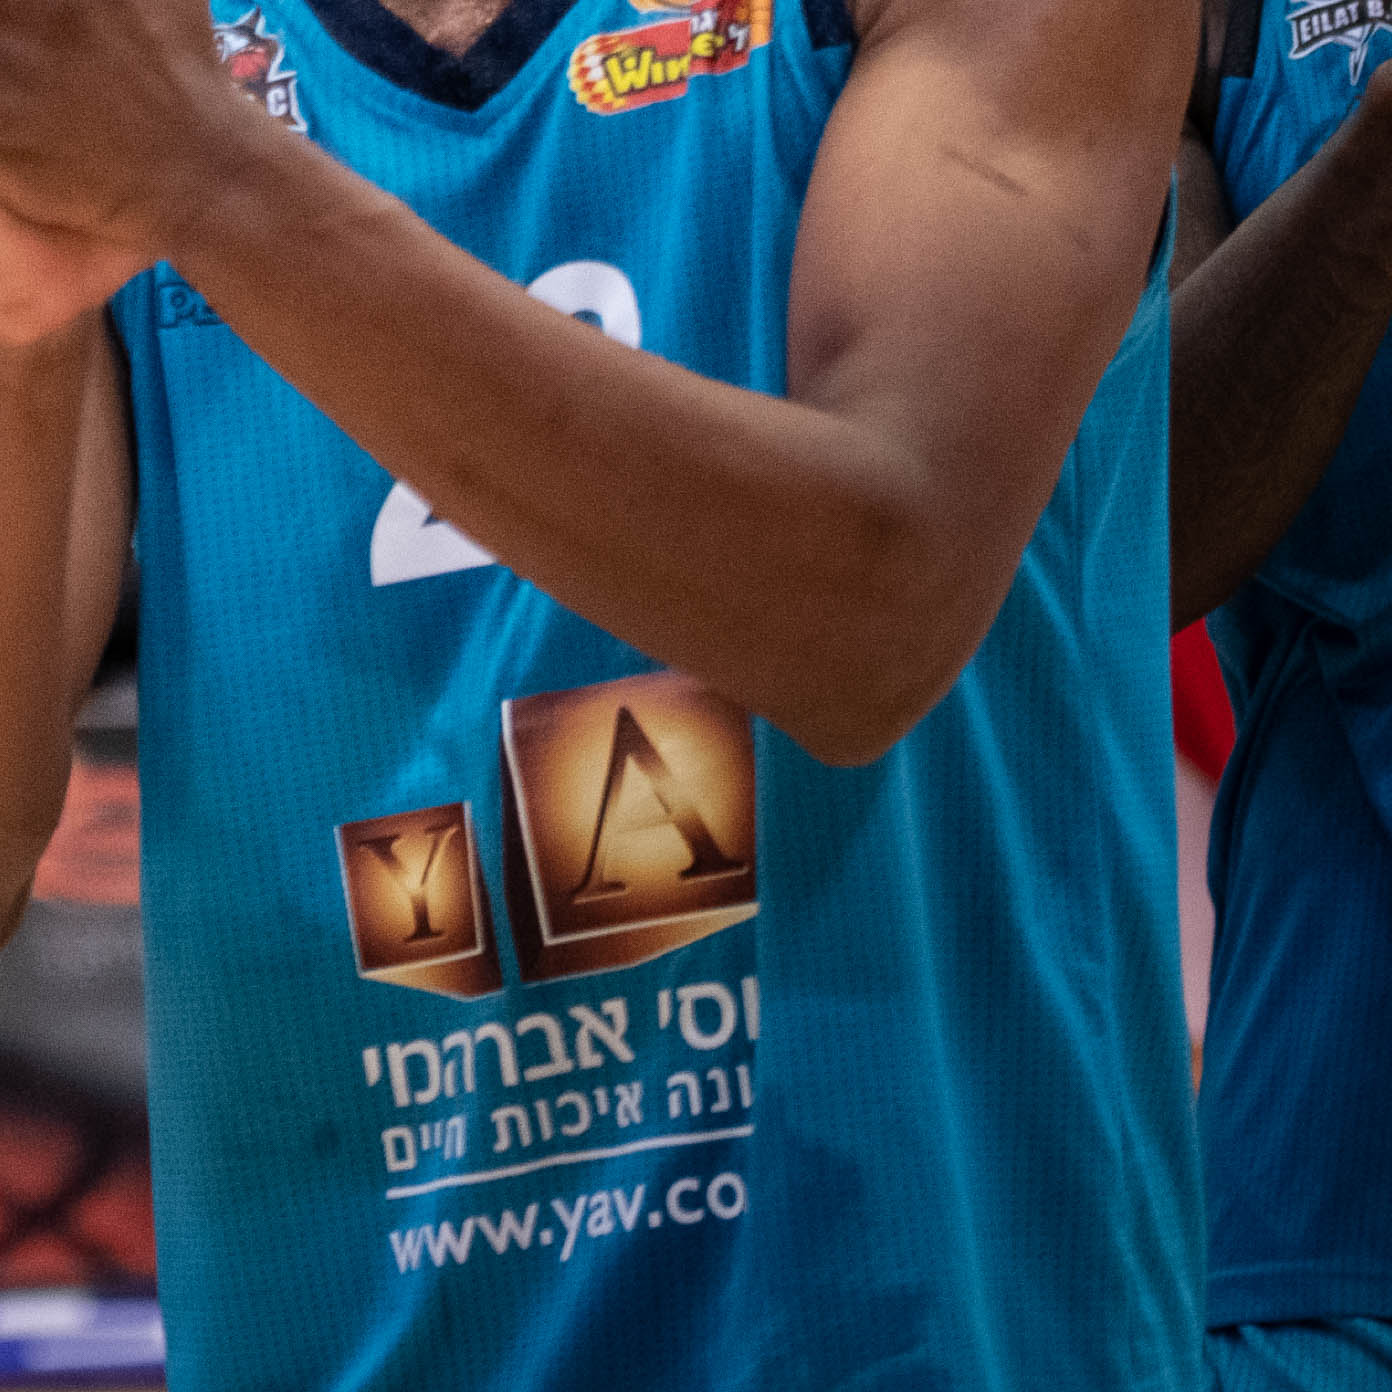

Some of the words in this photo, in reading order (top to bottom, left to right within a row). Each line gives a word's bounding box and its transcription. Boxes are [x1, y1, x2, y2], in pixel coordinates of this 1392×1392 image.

[1299, 1, 1360, 43] EILAT
[357, 823, 460, 945] Y
[572, 704, 750, 904] A
[363, 995, 636, 1108] אברהמי
[381, 1119, 468, 1173] חיים
[492, 1080, 644, 1154] איכות
